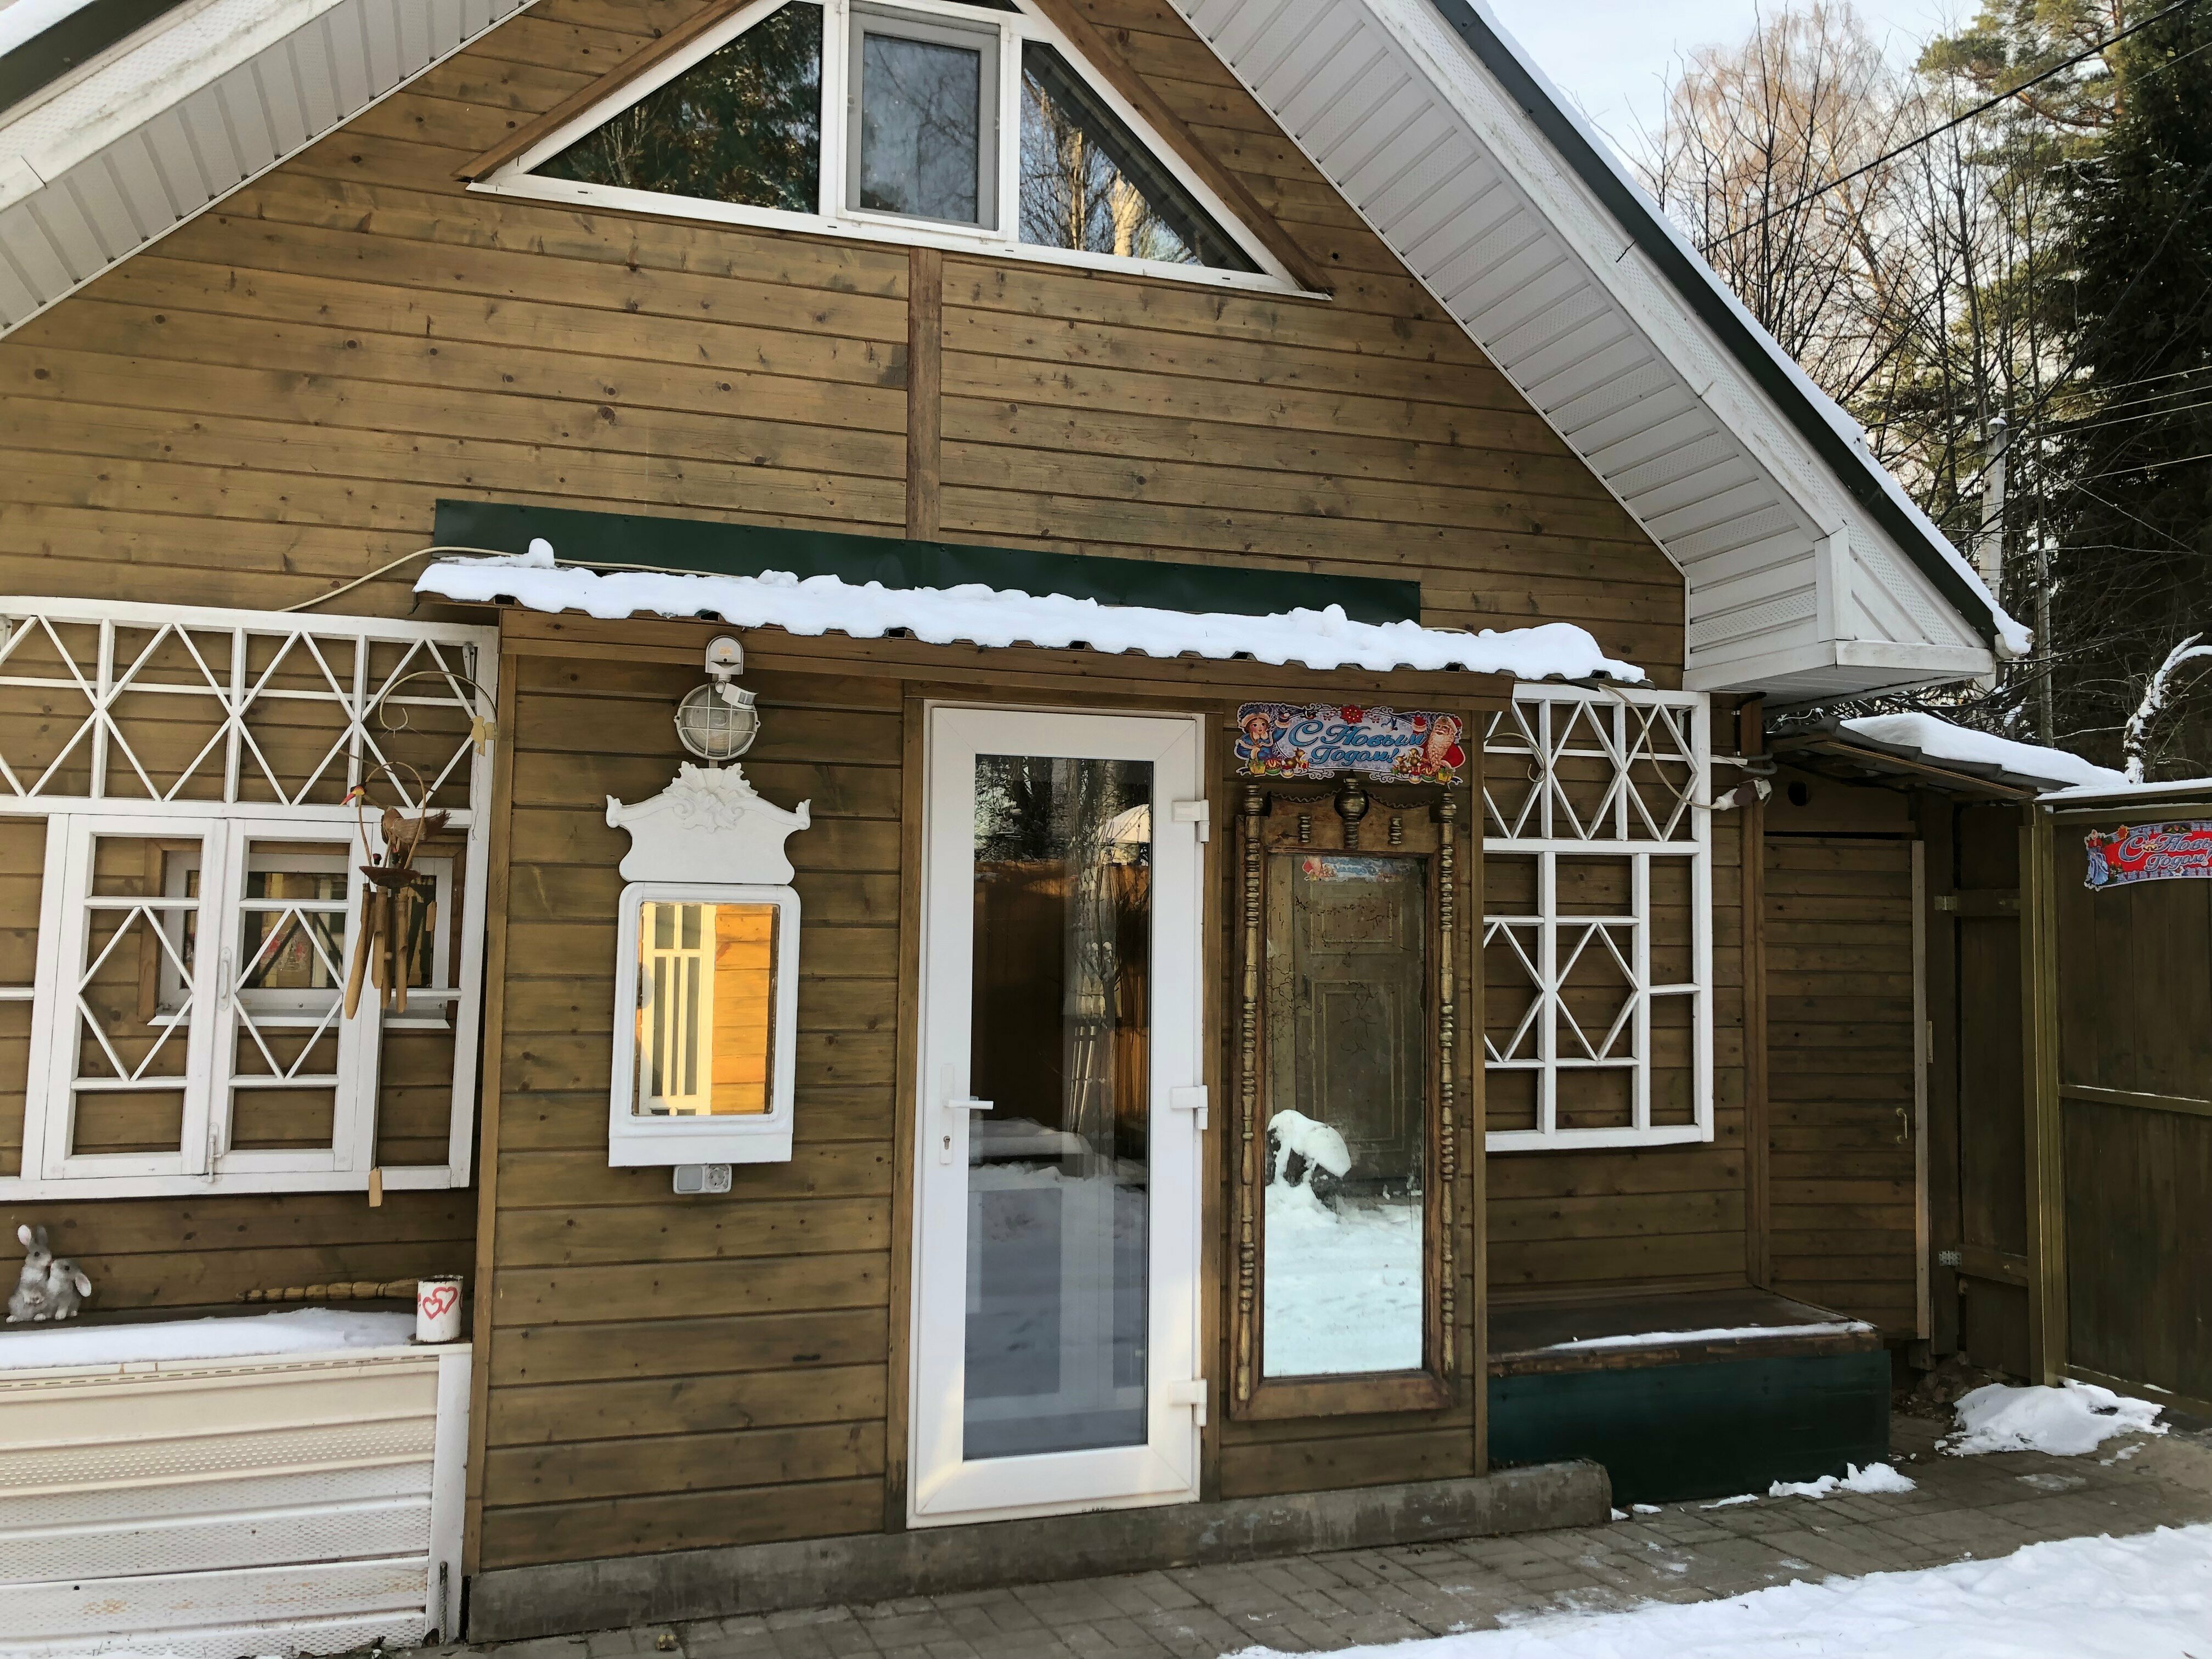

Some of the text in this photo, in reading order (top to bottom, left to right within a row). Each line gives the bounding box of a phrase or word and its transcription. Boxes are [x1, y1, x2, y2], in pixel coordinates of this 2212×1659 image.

[1289, 720, 1425, 747] С Новым
[1308, 745, 1400, 767] Годом!
[2119, 833, 2148, 862] С
[2144, 849, 2212, 871] Годом!
